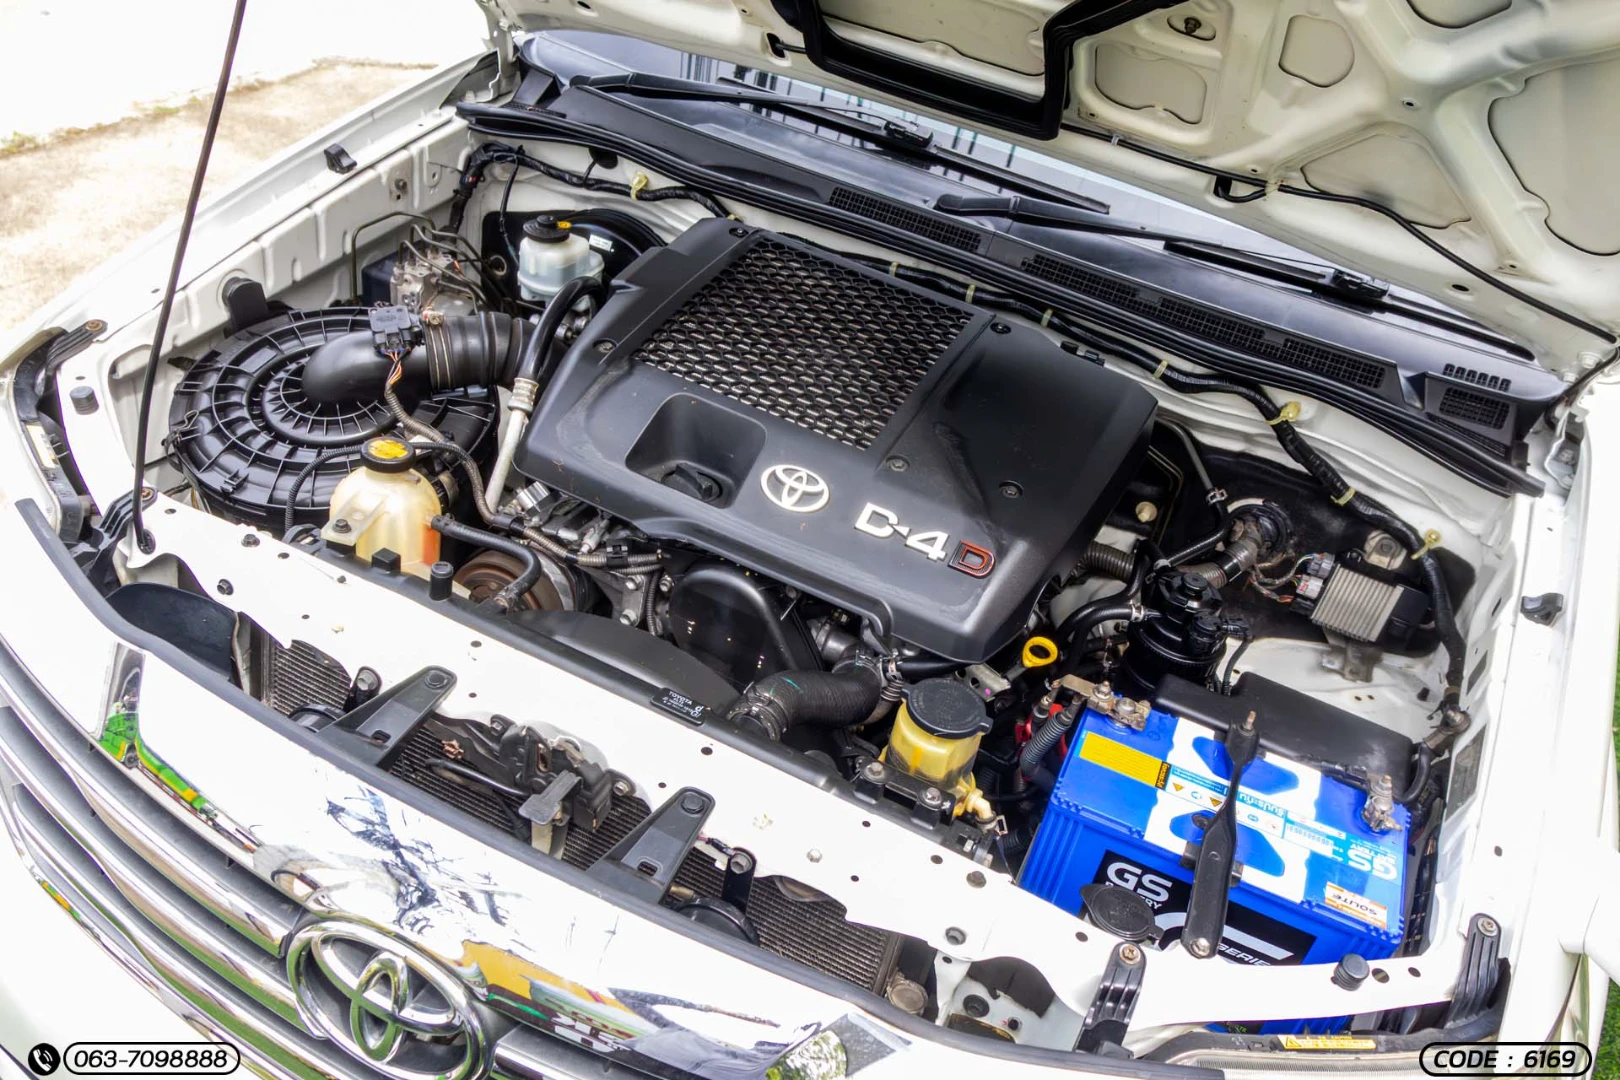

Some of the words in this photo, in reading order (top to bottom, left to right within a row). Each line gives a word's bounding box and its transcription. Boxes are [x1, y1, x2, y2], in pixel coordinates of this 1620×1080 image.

[668, 691, 693, 705] TOYOTA
[1347, 849, 1398, 880] GS
[1107, 862, 1173, 902] GS
[1332, 893, 1377, 916] SOLITE
[1218, 943, 1271, 966] SERIE
